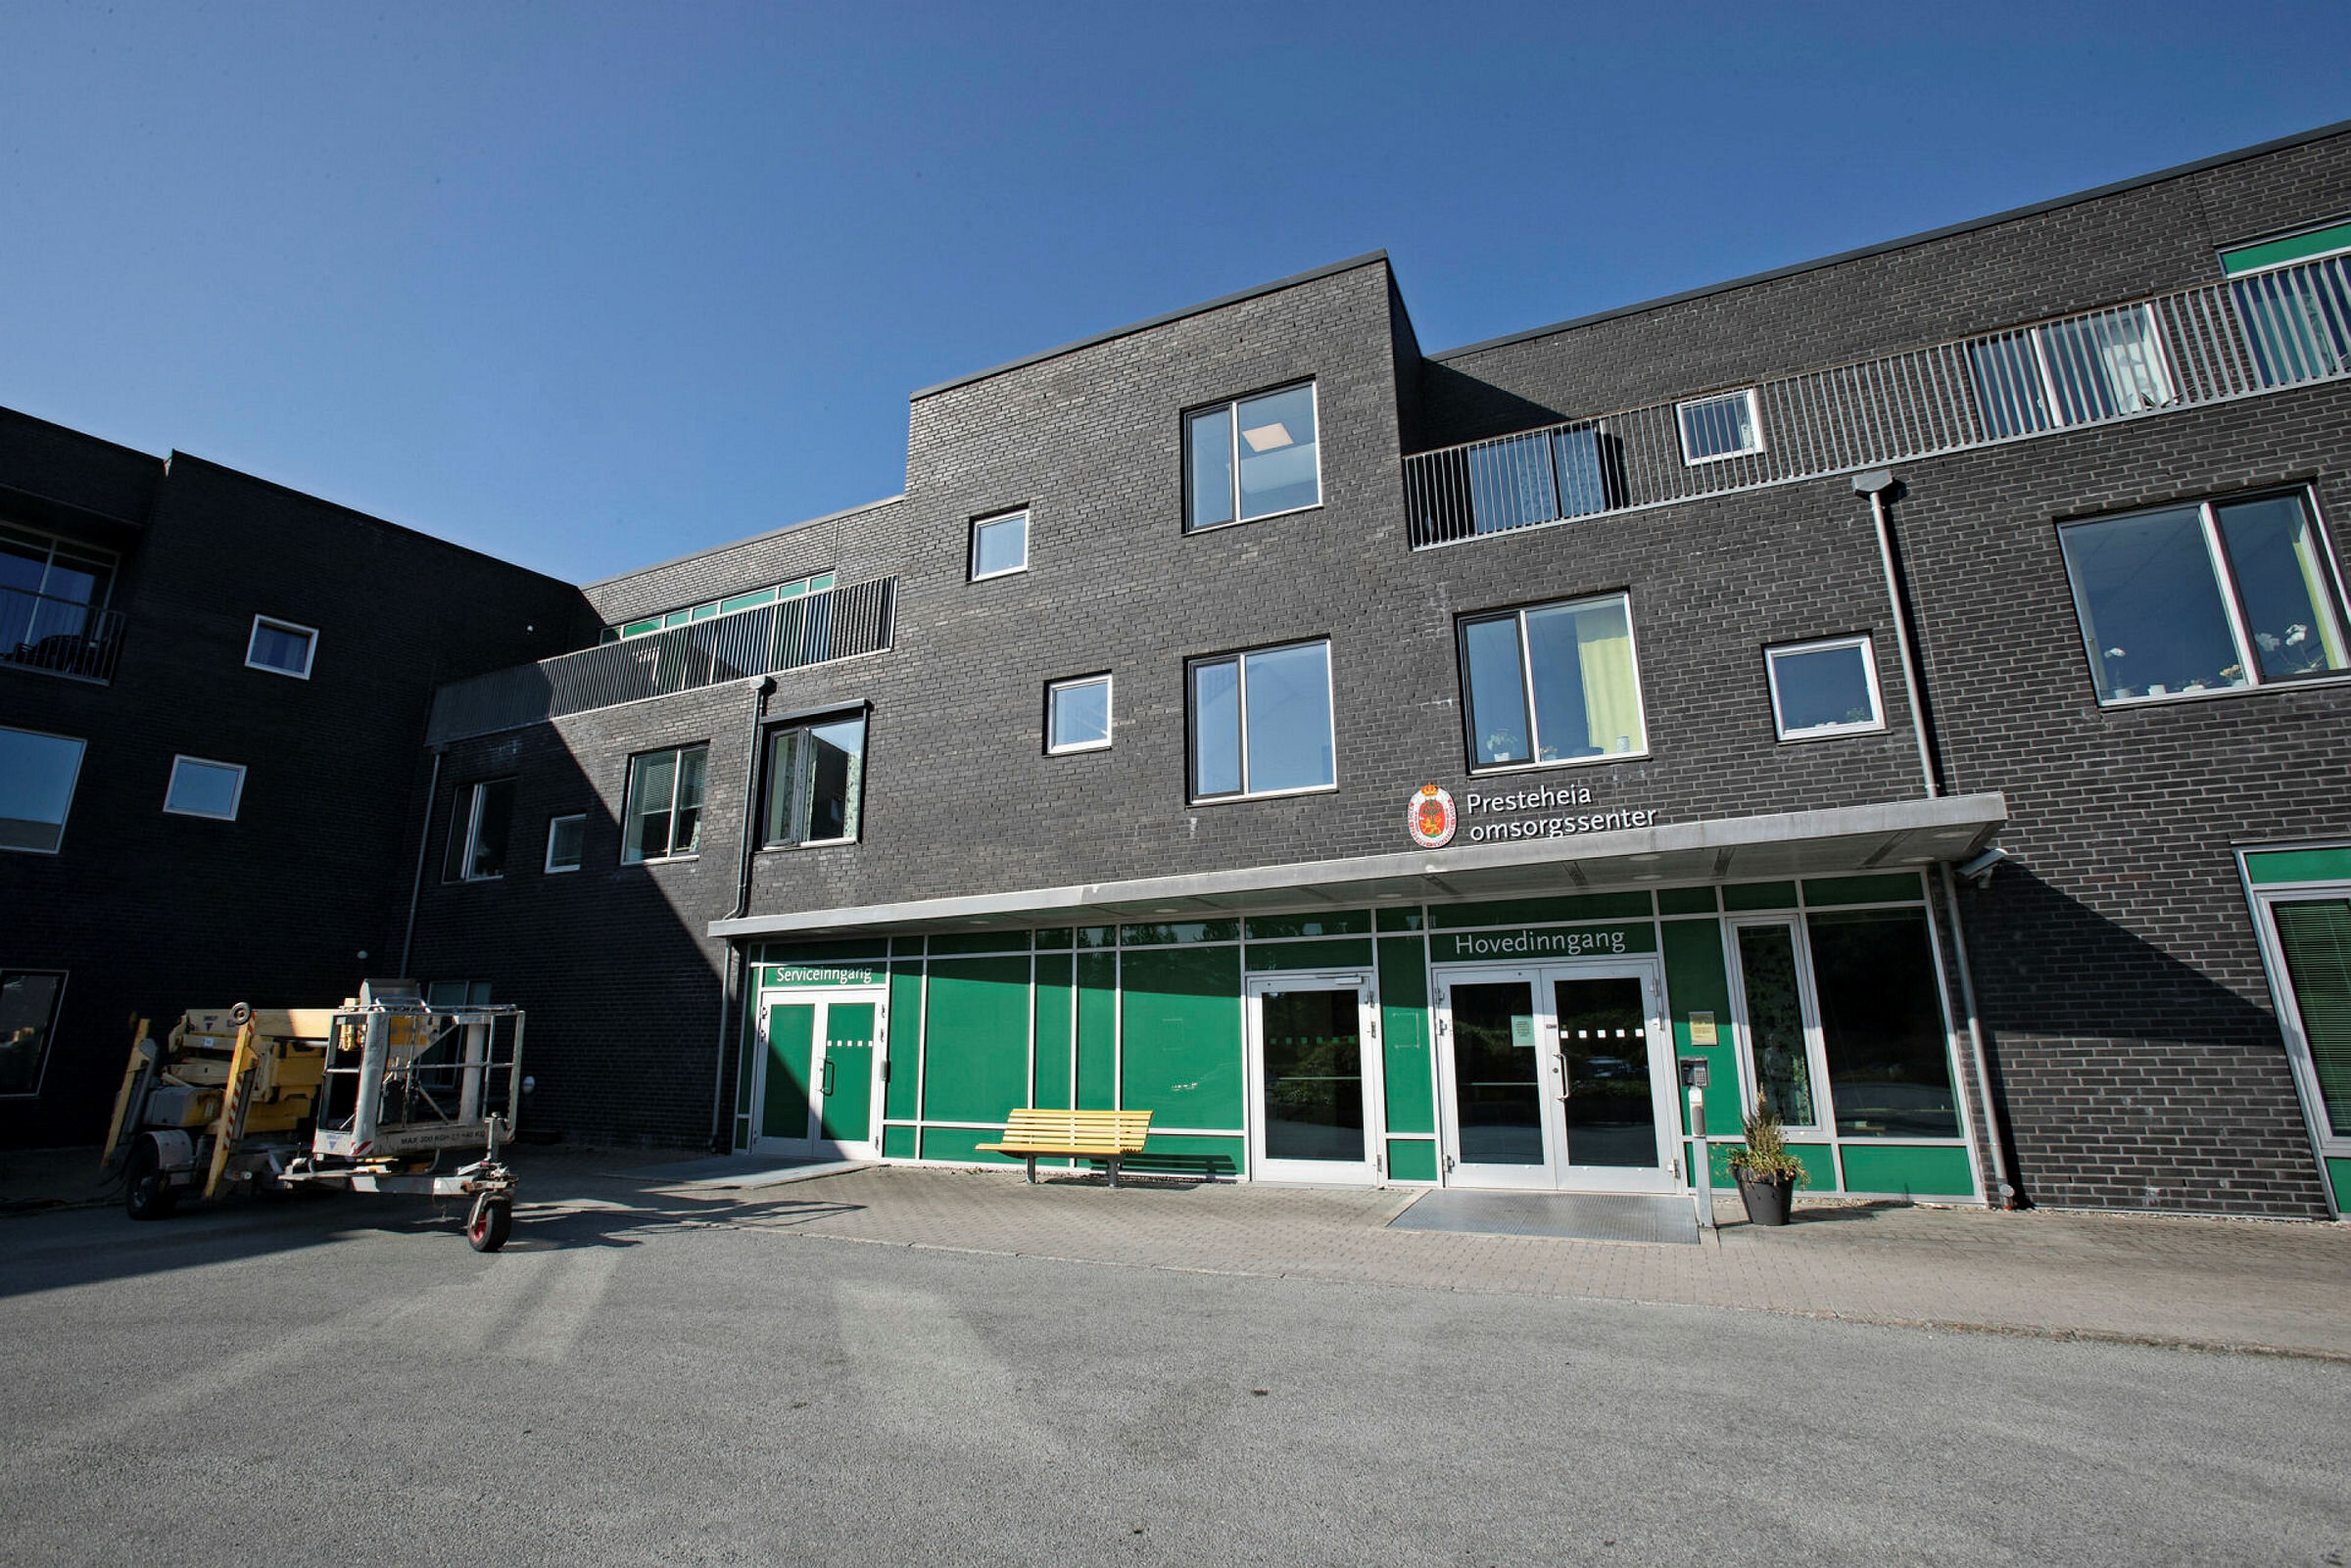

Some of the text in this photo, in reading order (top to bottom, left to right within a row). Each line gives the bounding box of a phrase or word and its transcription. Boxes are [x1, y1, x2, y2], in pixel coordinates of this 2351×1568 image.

[1466, 784, 1593, 814] Presteheia
[1470, 808, 1659, 840] omsorgssenter
[1456, 929, 1626, 955] Hovedinngang
[777, 967, 872, 984] Serviceinngang
